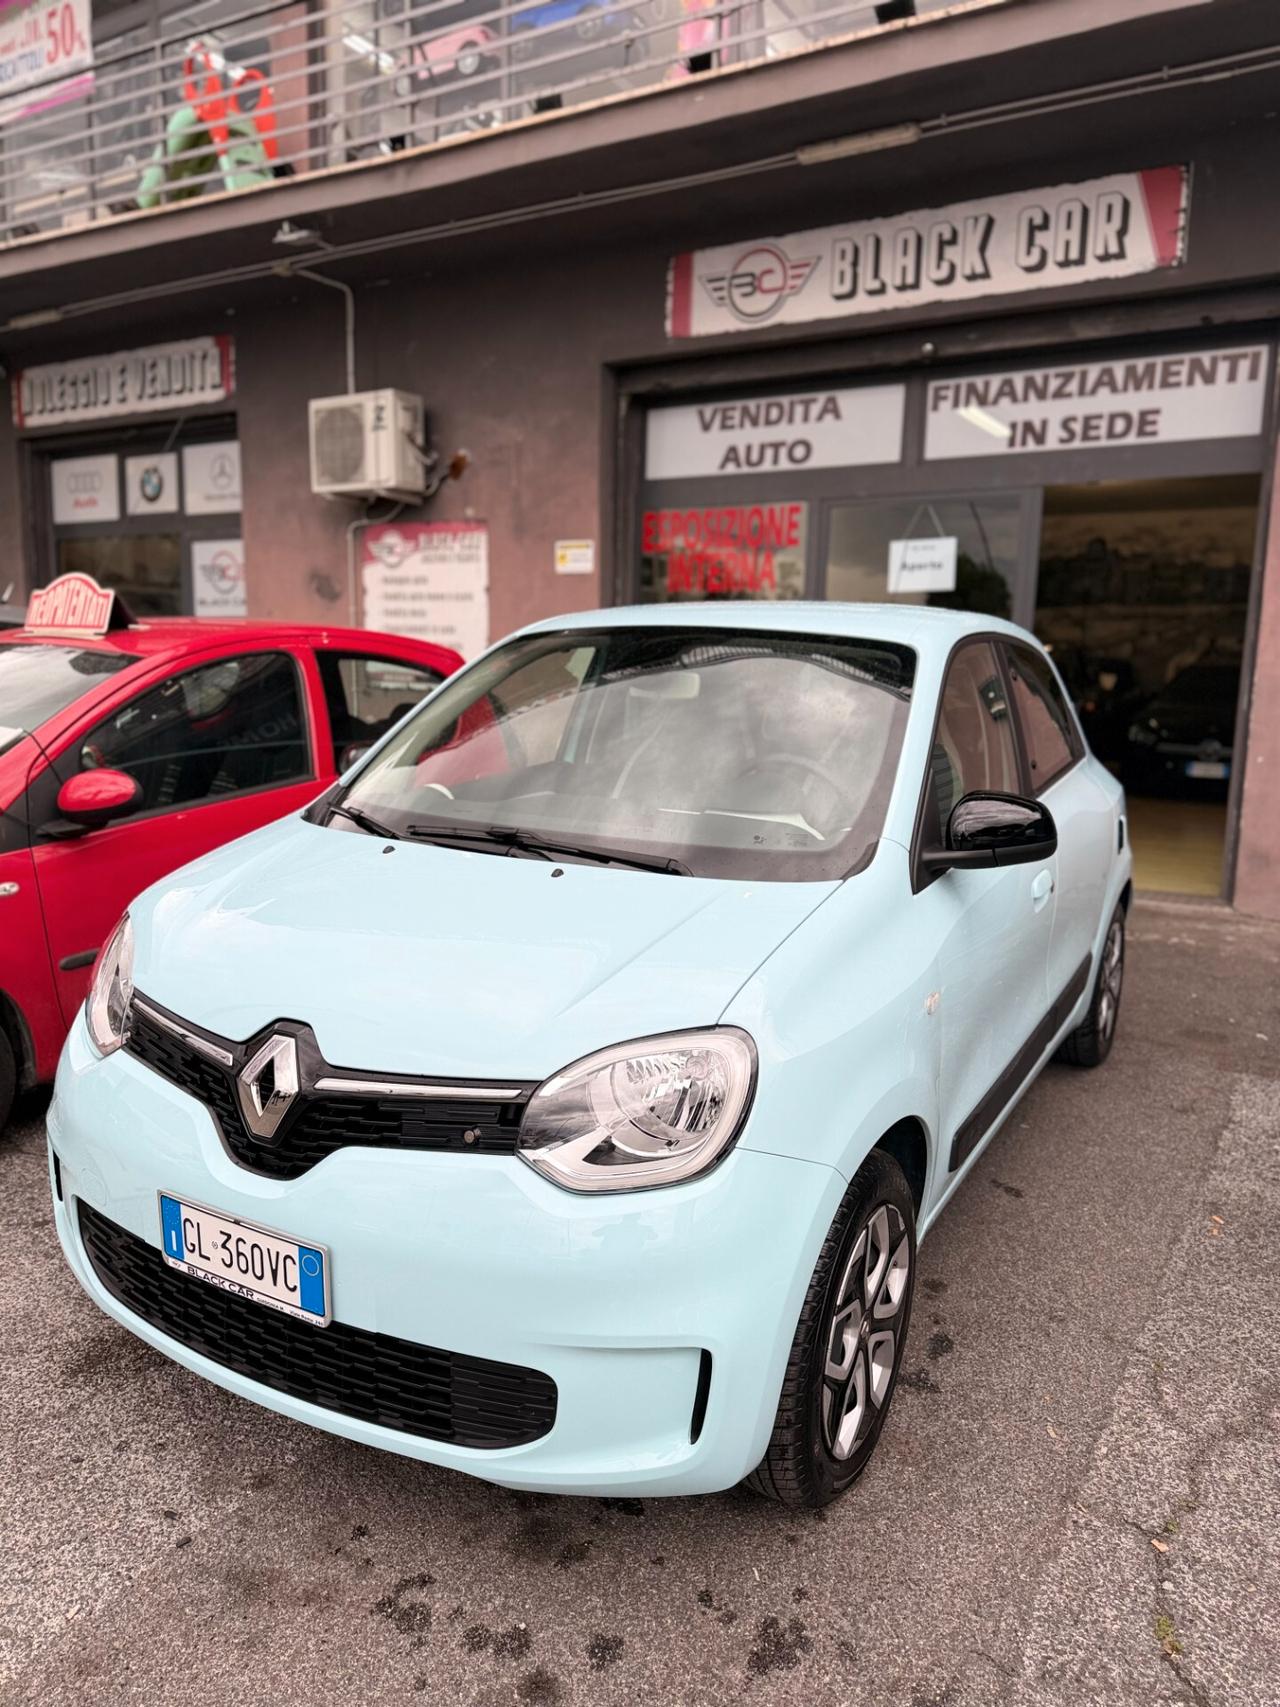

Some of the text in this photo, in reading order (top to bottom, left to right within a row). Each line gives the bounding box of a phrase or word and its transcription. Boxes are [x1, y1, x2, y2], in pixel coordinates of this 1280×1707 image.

[831, 192, 1130, 300] BLACK CAR
[133, 349, 222, 401] VENDITA
[931, 351, 1262, 412] FINANZIAMENTI
[697, 396, 842, 432] VENDITA
[1007, 409, 1161, 448] IN SEDE
[718, 439, 812, 471] AUTO
[642, 505, 802, 554] ESPOSIZIONE
[666, 550, 776, 593] INTERNA
[187, 1266, 226, 1289] BLACK
[228, 1282, 255, 1300] CAR
